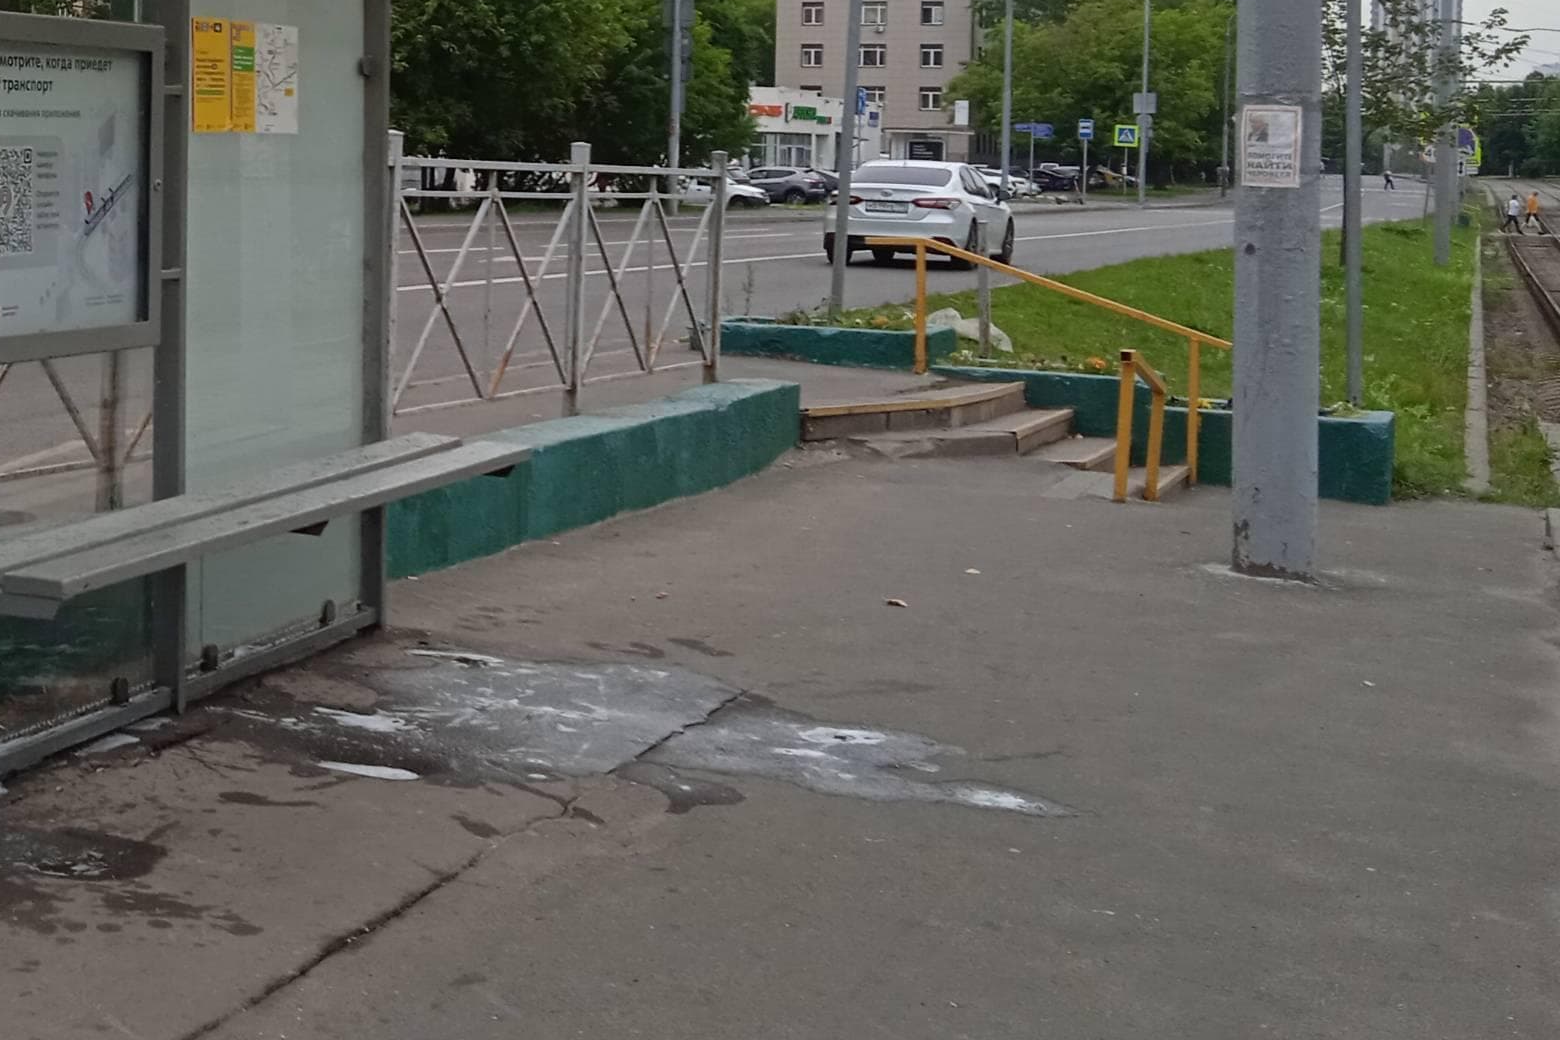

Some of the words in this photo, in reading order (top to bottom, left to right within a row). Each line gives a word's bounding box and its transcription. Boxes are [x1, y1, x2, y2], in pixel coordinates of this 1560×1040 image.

[45, 57, 72, 70] когда
[74, 59, 112, 71] приедет
[2, 79, 53, 93] транспорт
